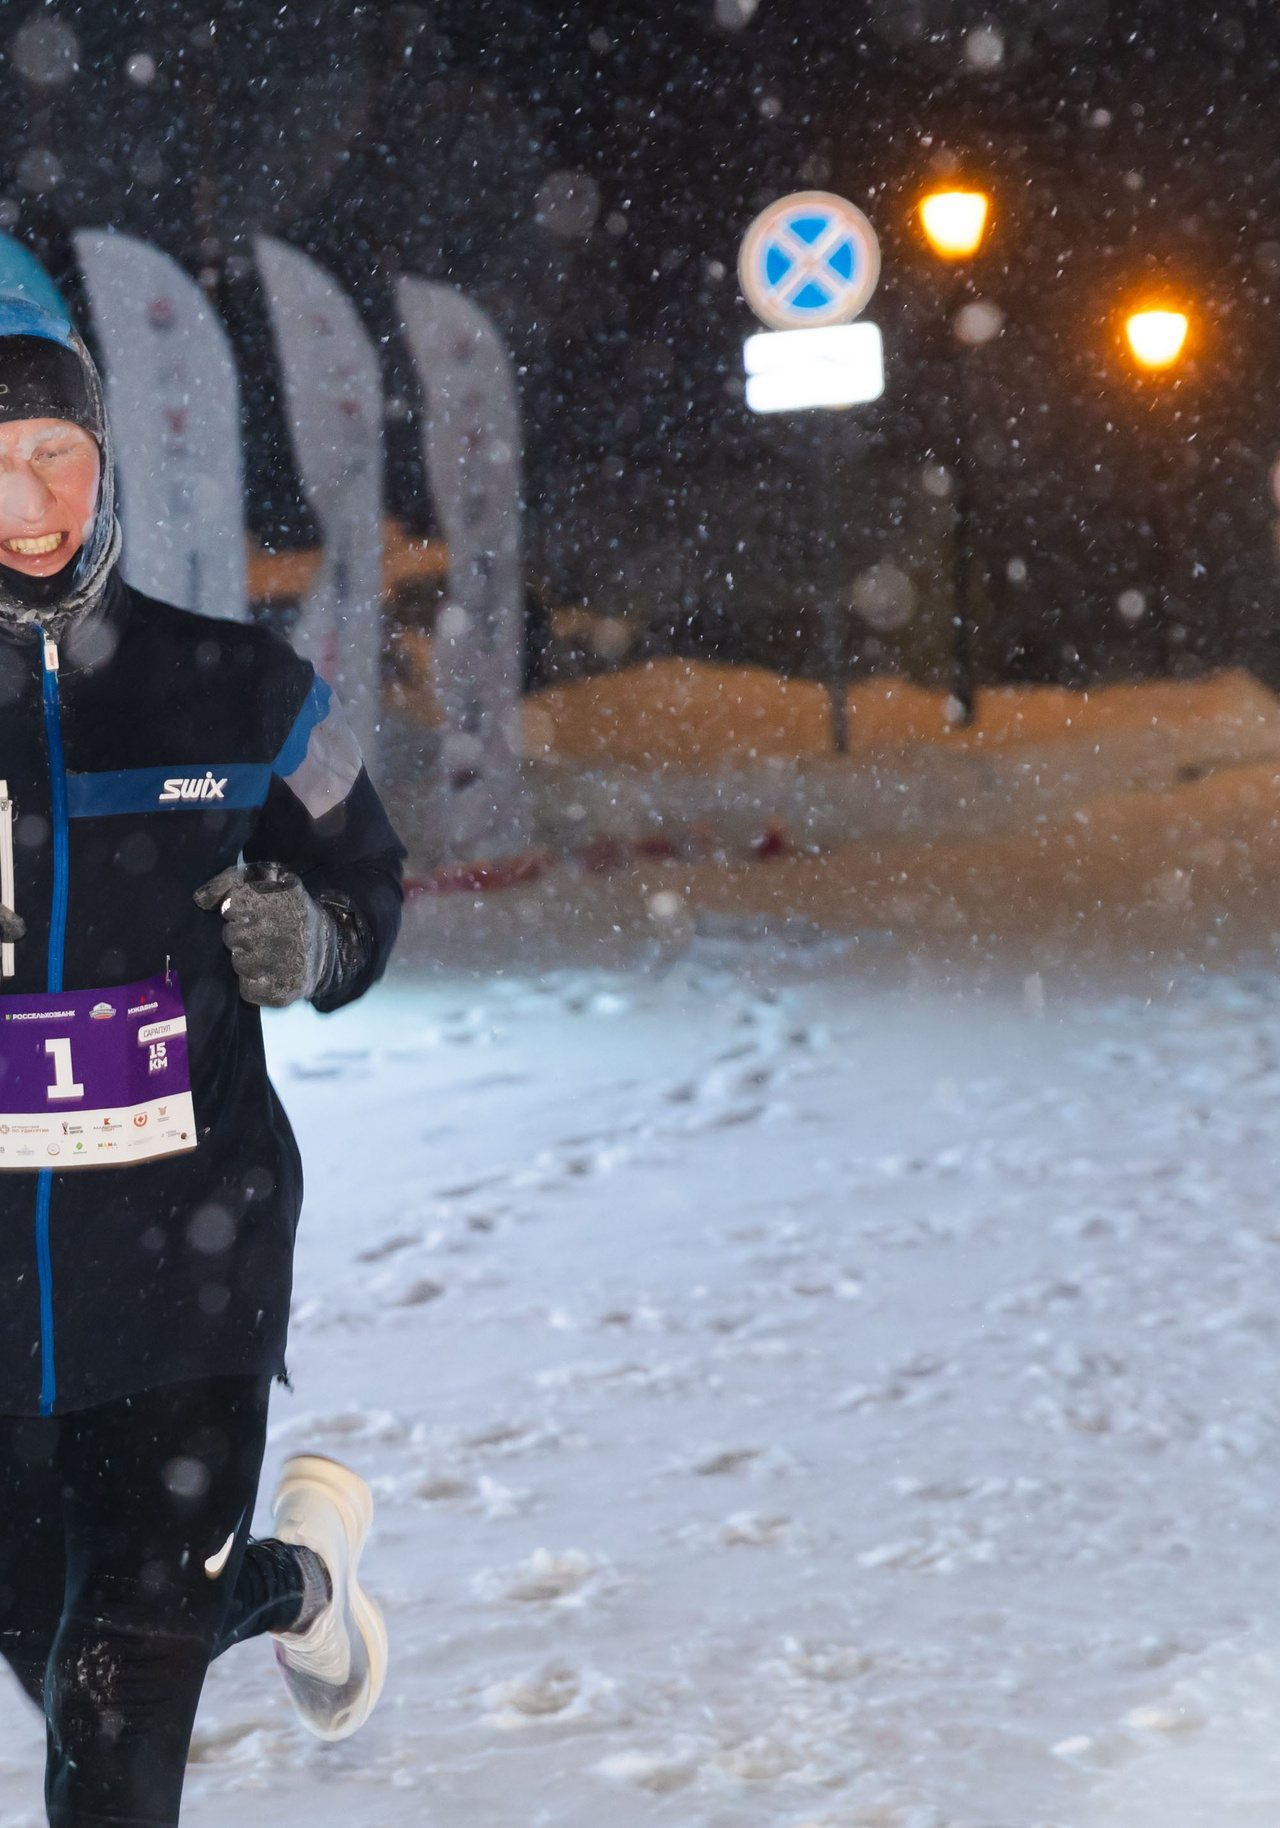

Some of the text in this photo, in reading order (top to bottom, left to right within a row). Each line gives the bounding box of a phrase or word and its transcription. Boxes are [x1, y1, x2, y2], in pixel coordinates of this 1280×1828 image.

[143, 1024, 171, 1038] САРАПУЛ
[149, 1041, 167, 1060] 15
[45, 1037, 85, 1099] 1
[149, 1056, 168, 1072] КМ
